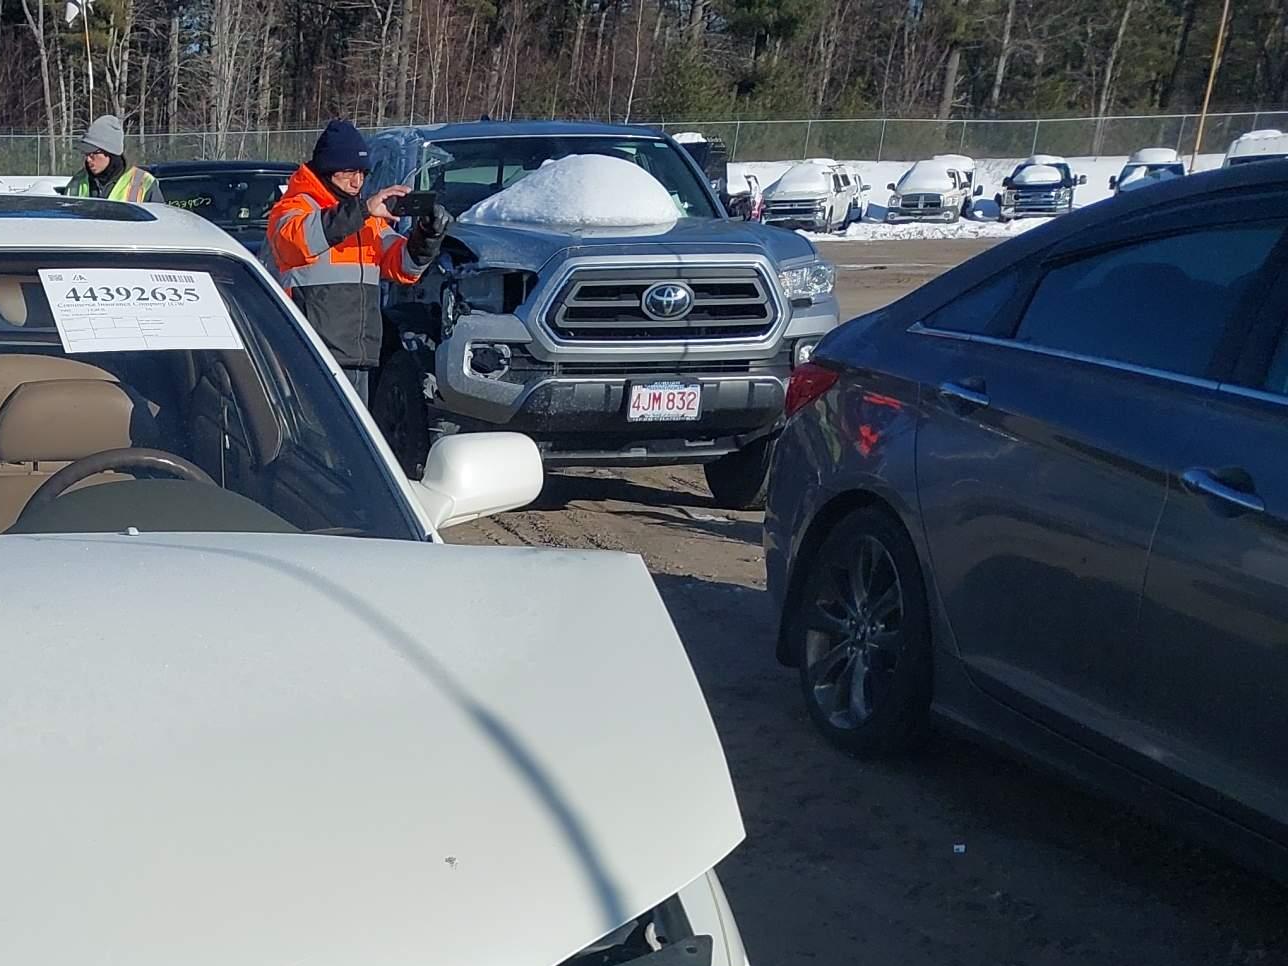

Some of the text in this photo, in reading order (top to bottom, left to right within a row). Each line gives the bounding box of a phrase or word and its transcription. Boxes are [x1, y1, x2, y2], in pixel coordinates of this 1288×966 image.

[65, 286, 200, 302] 44392635
[632, 391, 697, 411] 4JM 832
